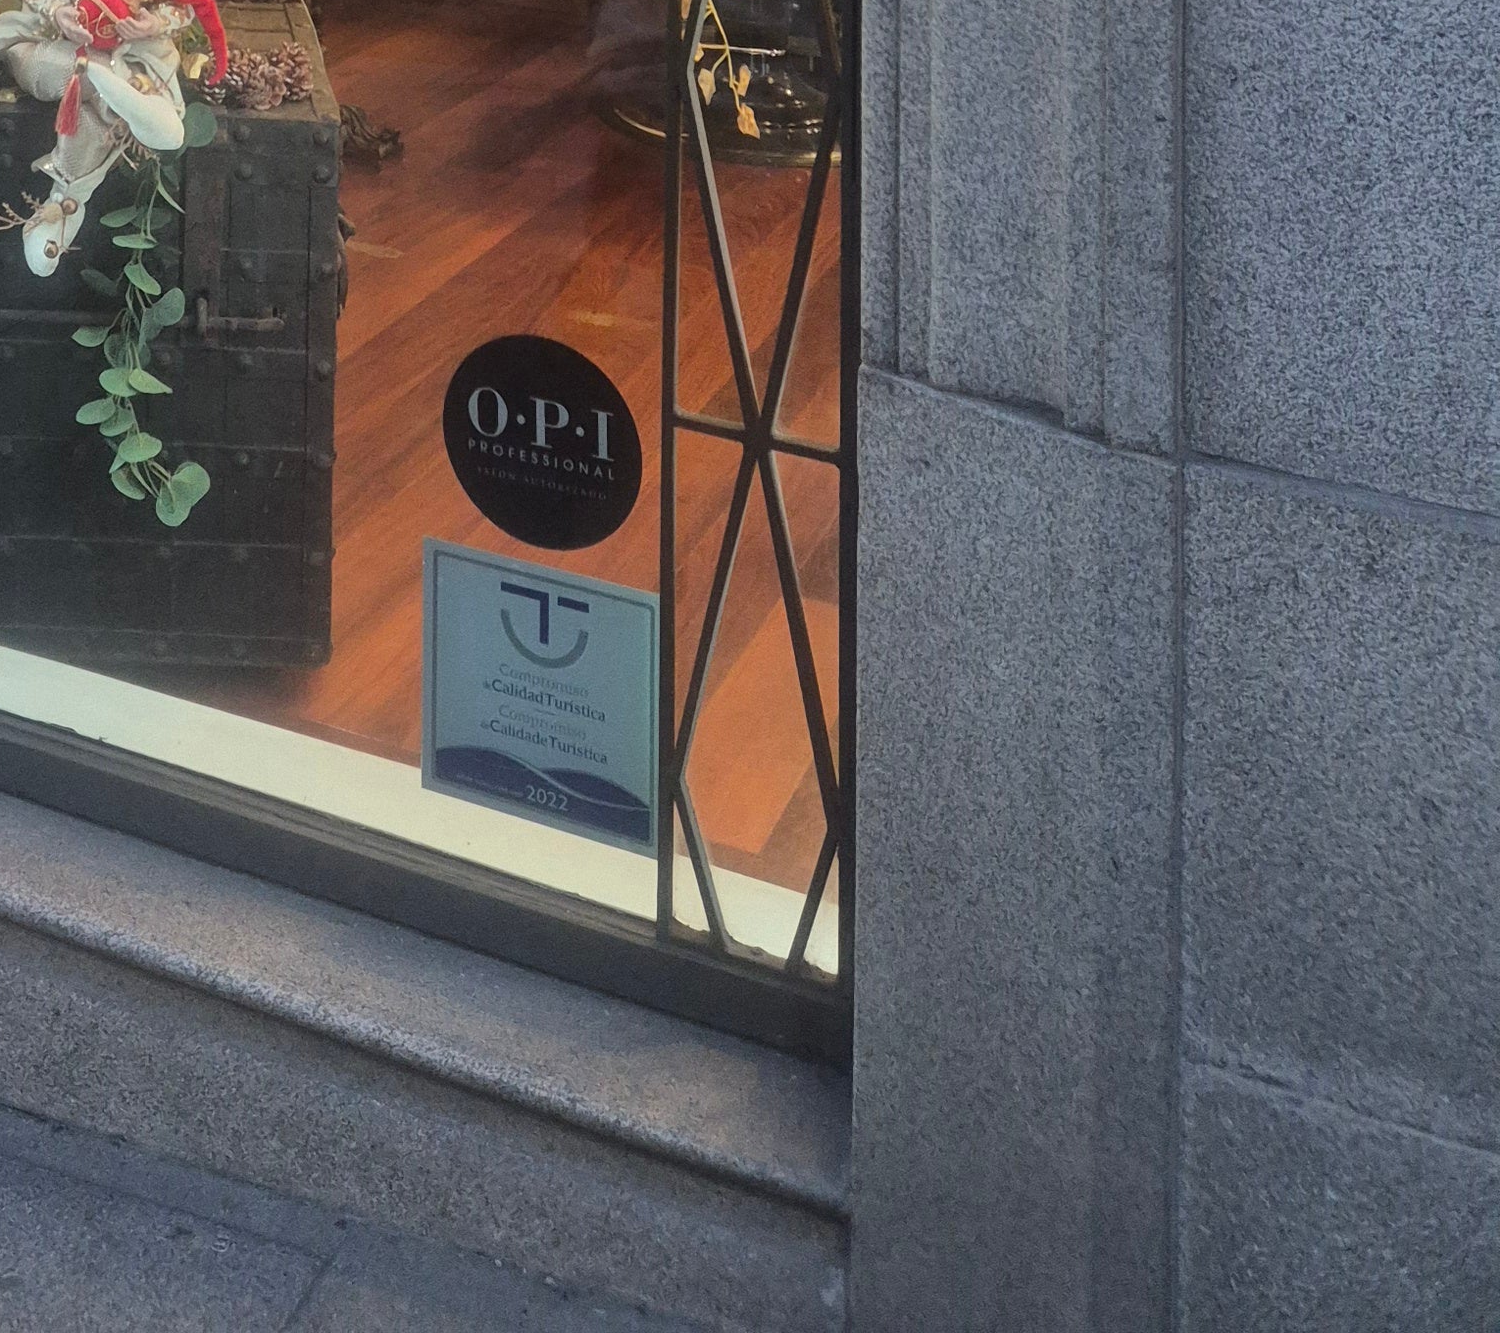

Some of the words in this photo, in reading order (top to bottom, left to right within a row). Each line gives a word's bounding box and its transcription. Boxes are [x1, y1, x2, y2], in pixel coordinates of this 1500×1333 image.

[468, 438, 615, 481] PROFESSIONAL
[491, 678, 544, 704] Calidad
[490, 719, 549, 747] Calidade
[525, 784, 569, 812] 2022
